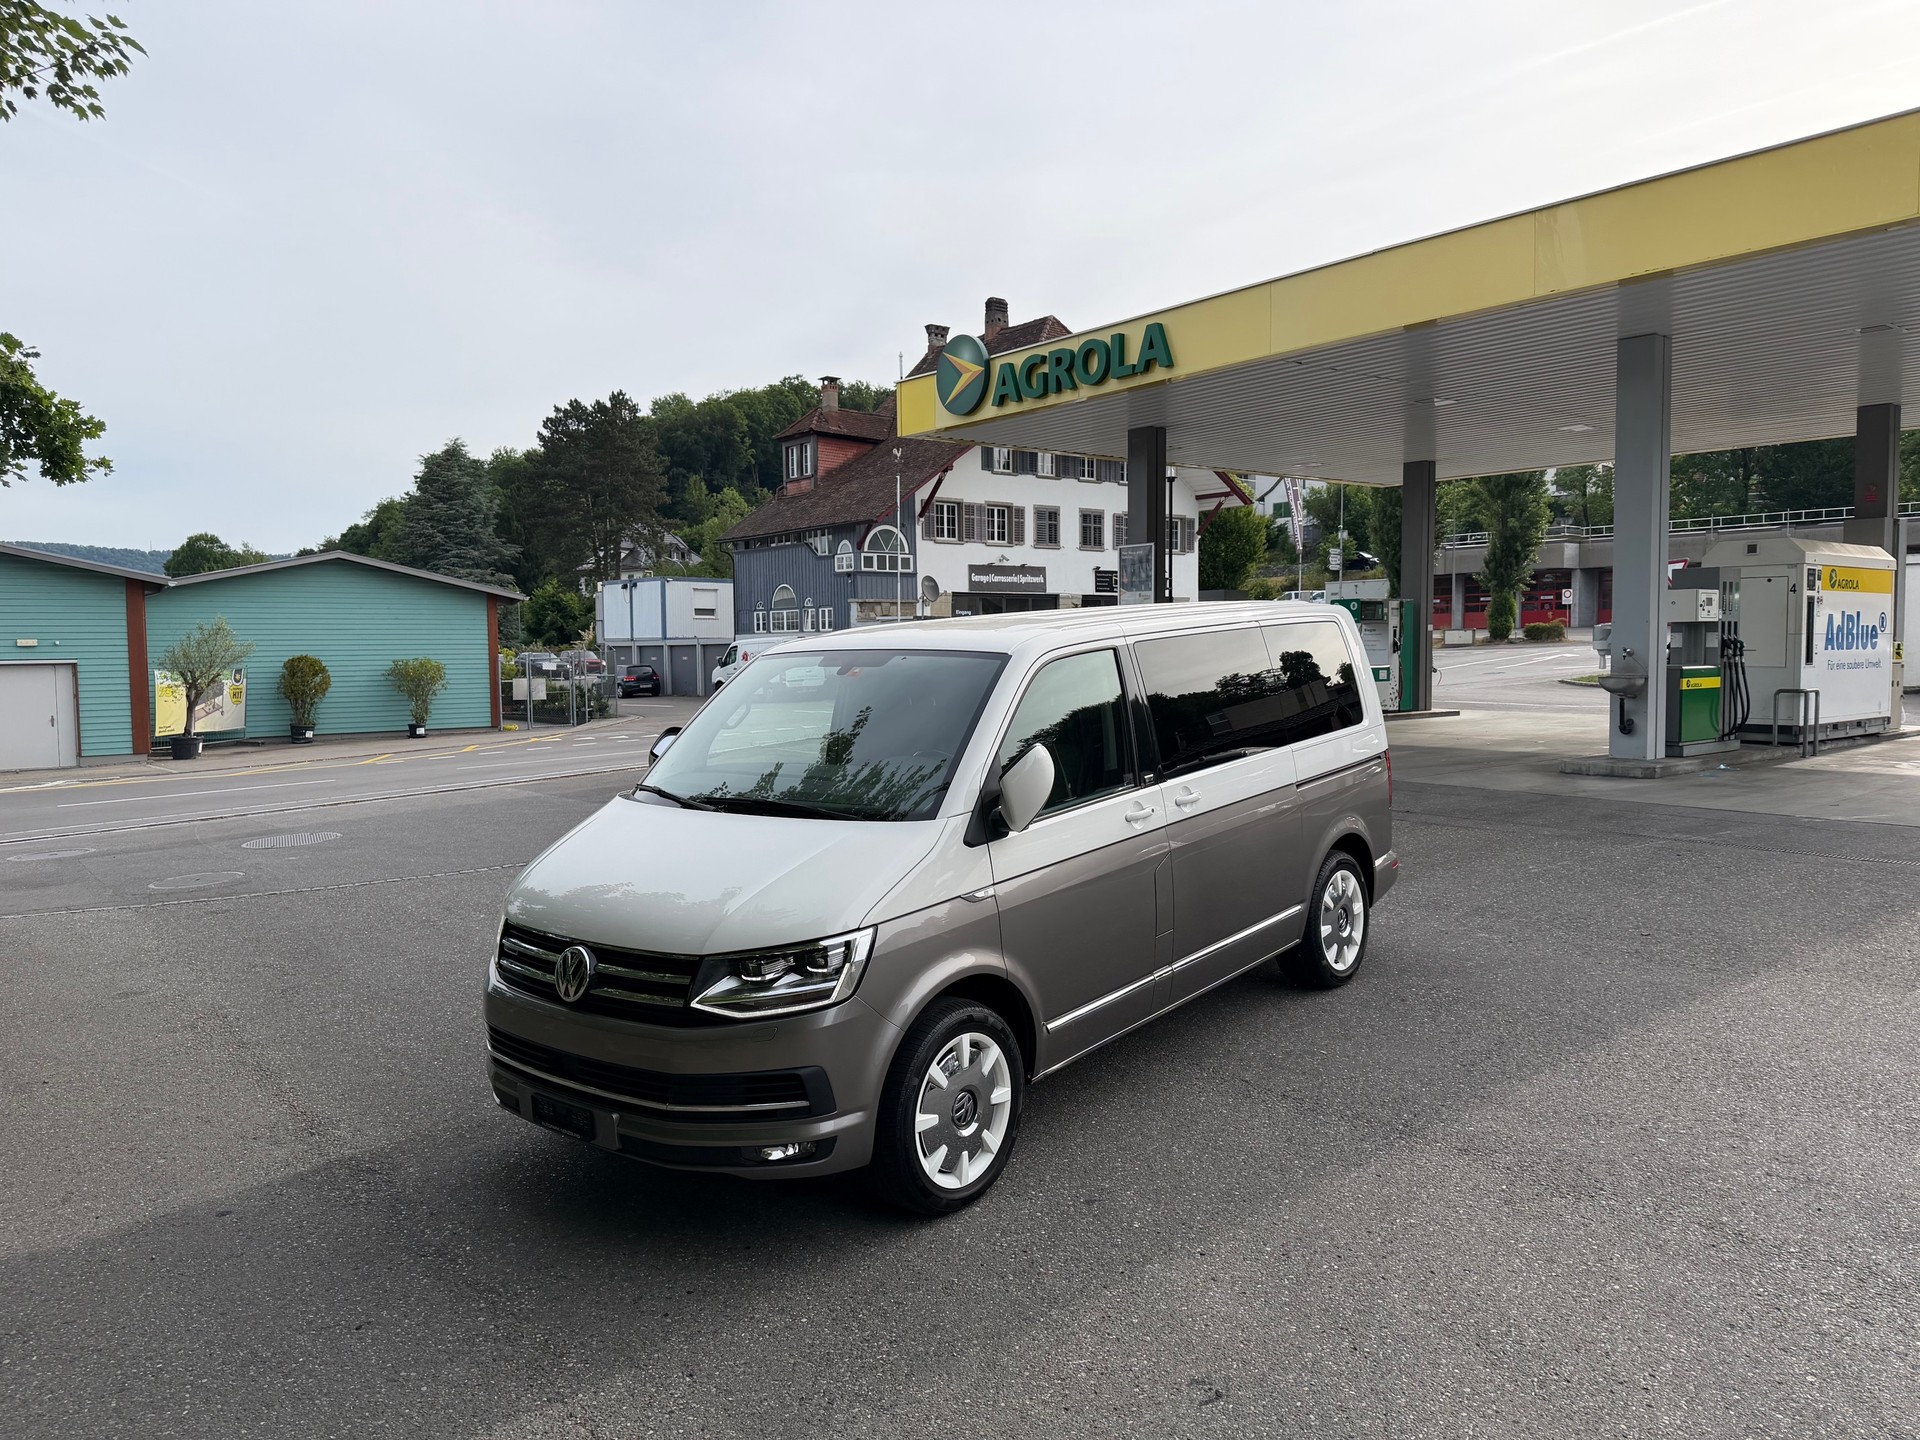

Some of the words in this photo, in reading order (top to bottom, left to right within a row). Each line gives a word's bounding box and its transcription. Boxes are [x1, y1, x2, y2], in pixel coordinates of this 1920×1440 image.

[991, 322, 1174, 407] AGROLA
[1789, 583, 1797, 594] 4
[1836, 578, 1860, 590] AGROLA
[1827, 659, 1835, 671] Für
[1836, 660, 1846, 670] eine
